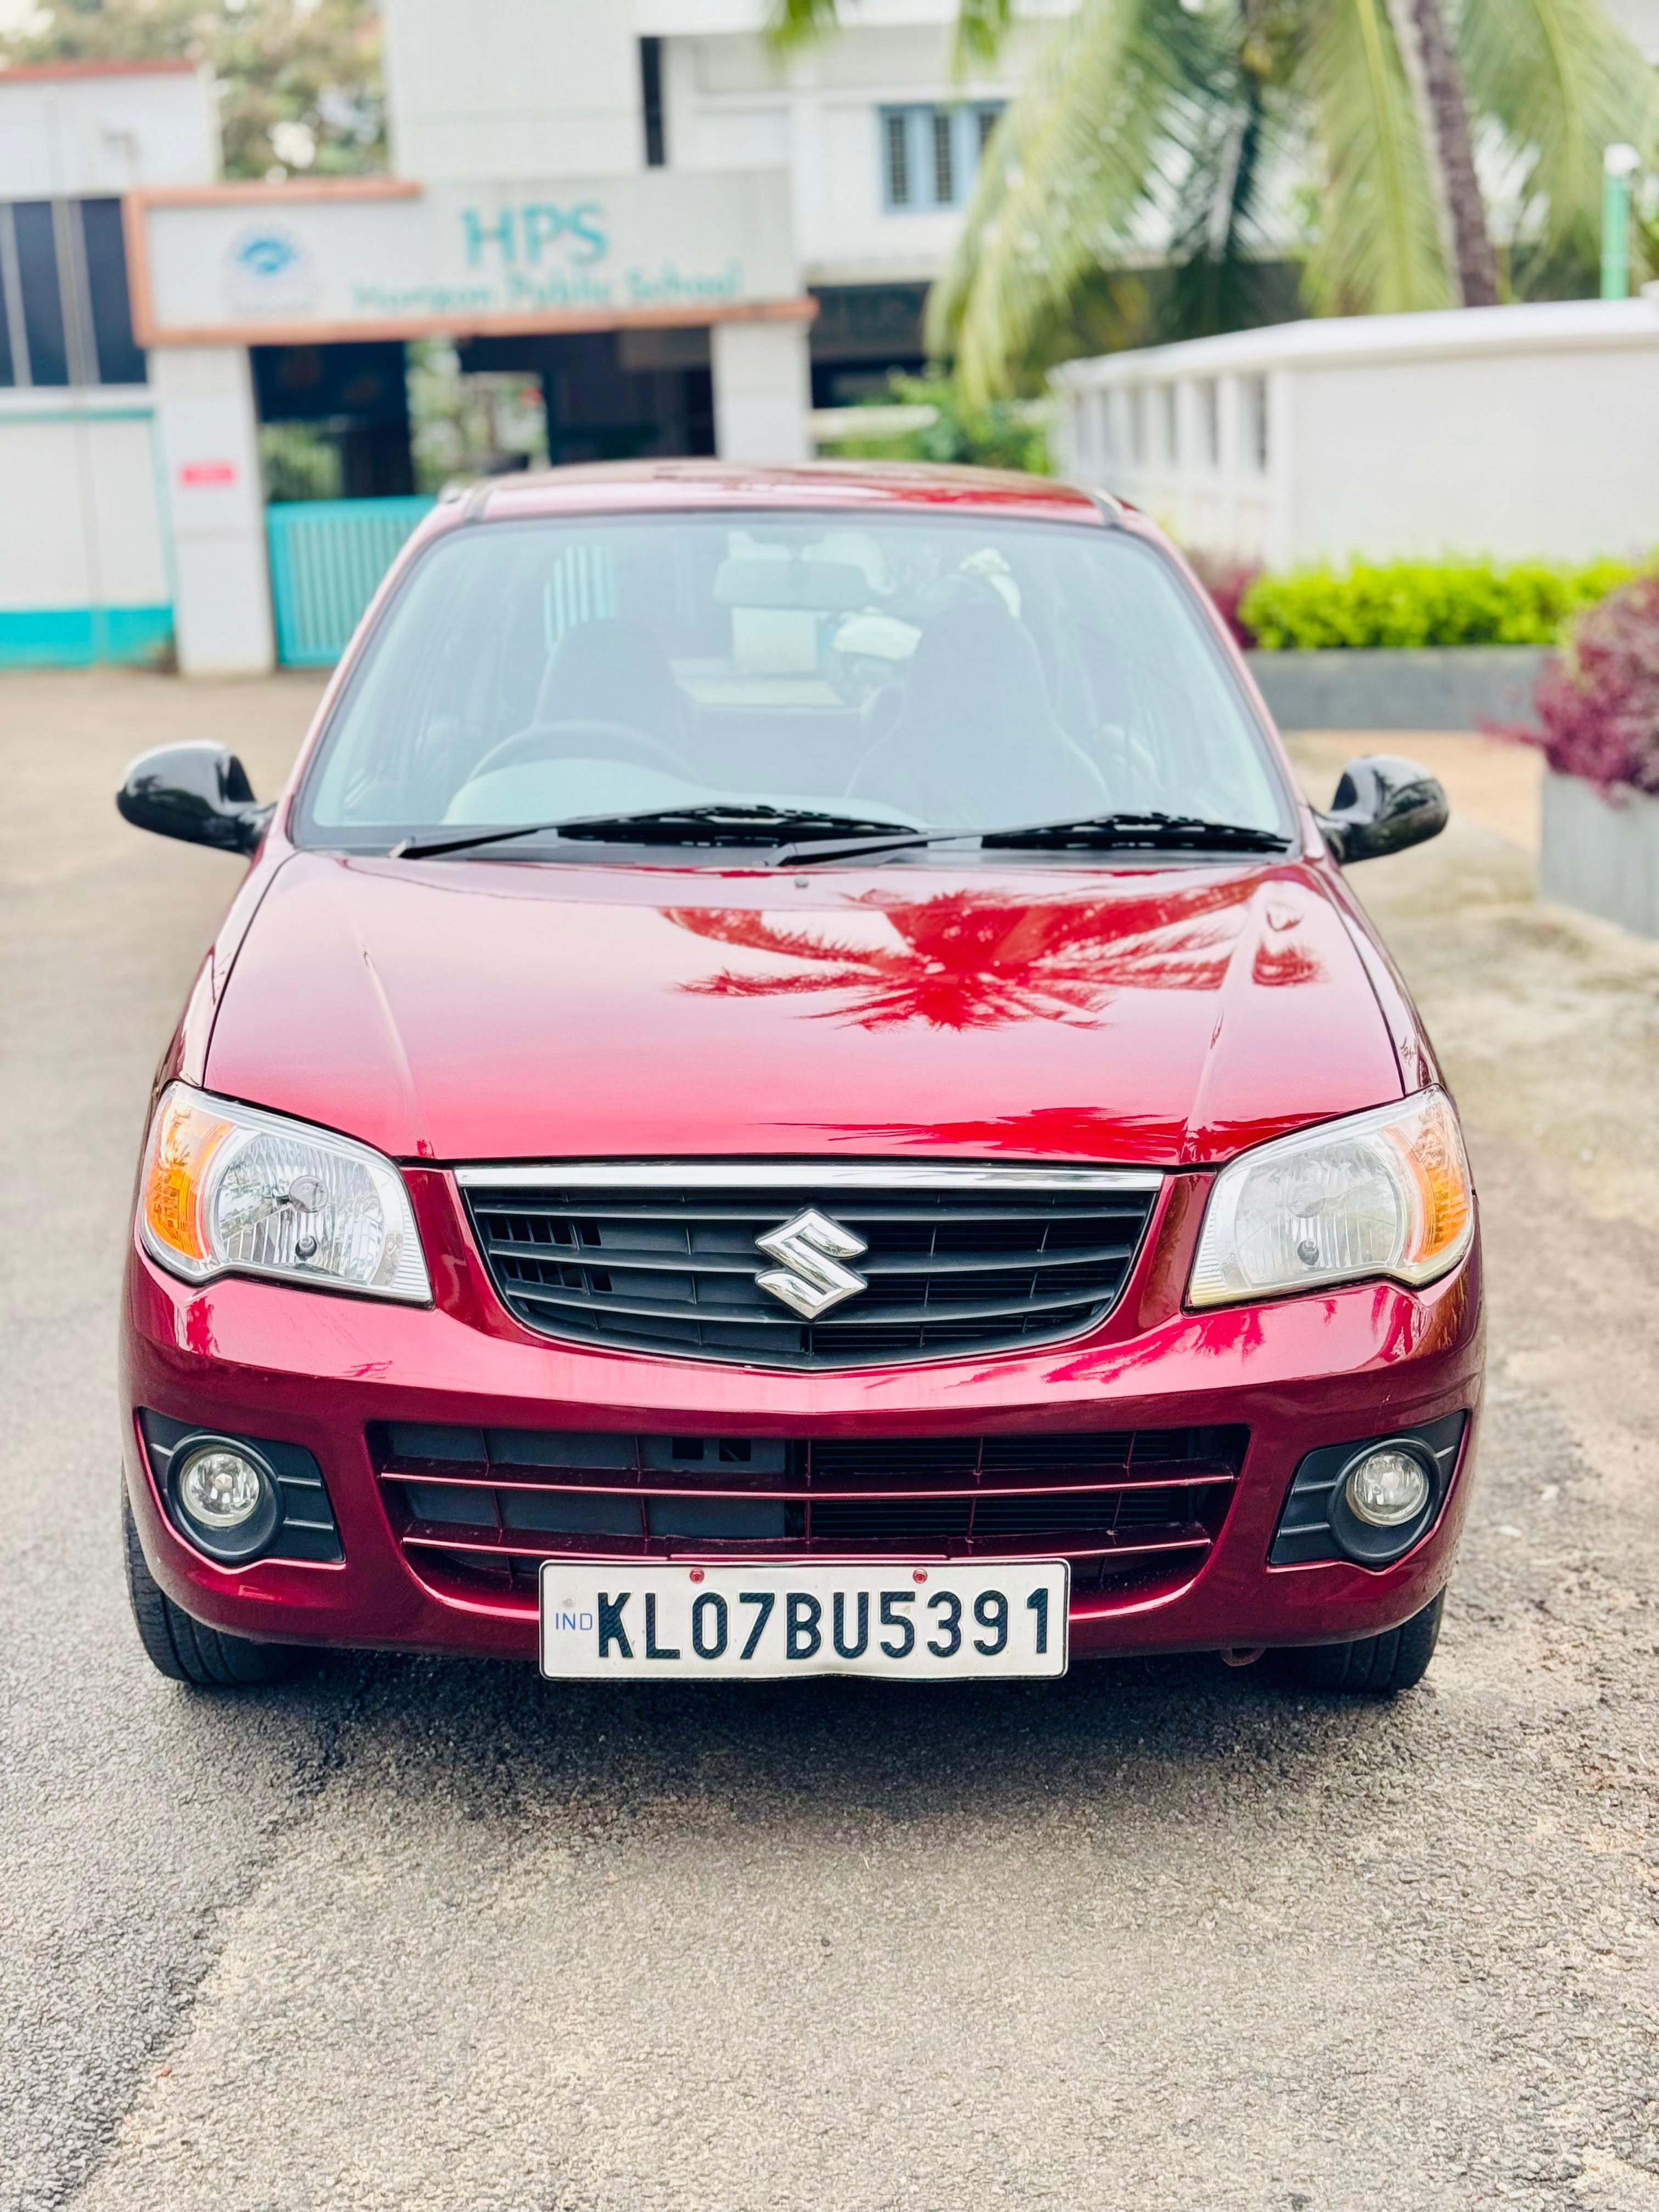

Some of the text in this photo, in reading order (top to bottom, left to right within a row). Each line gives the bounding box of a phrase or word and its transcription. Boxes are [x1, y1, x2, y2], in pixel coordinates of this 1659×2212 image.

[462, 202, 610, 266] HPS
[509, 270, 612, 305] Public
[627, 259, 742, 299] School
[555, 1587, 1049, 1660] IND KL07BU5391
